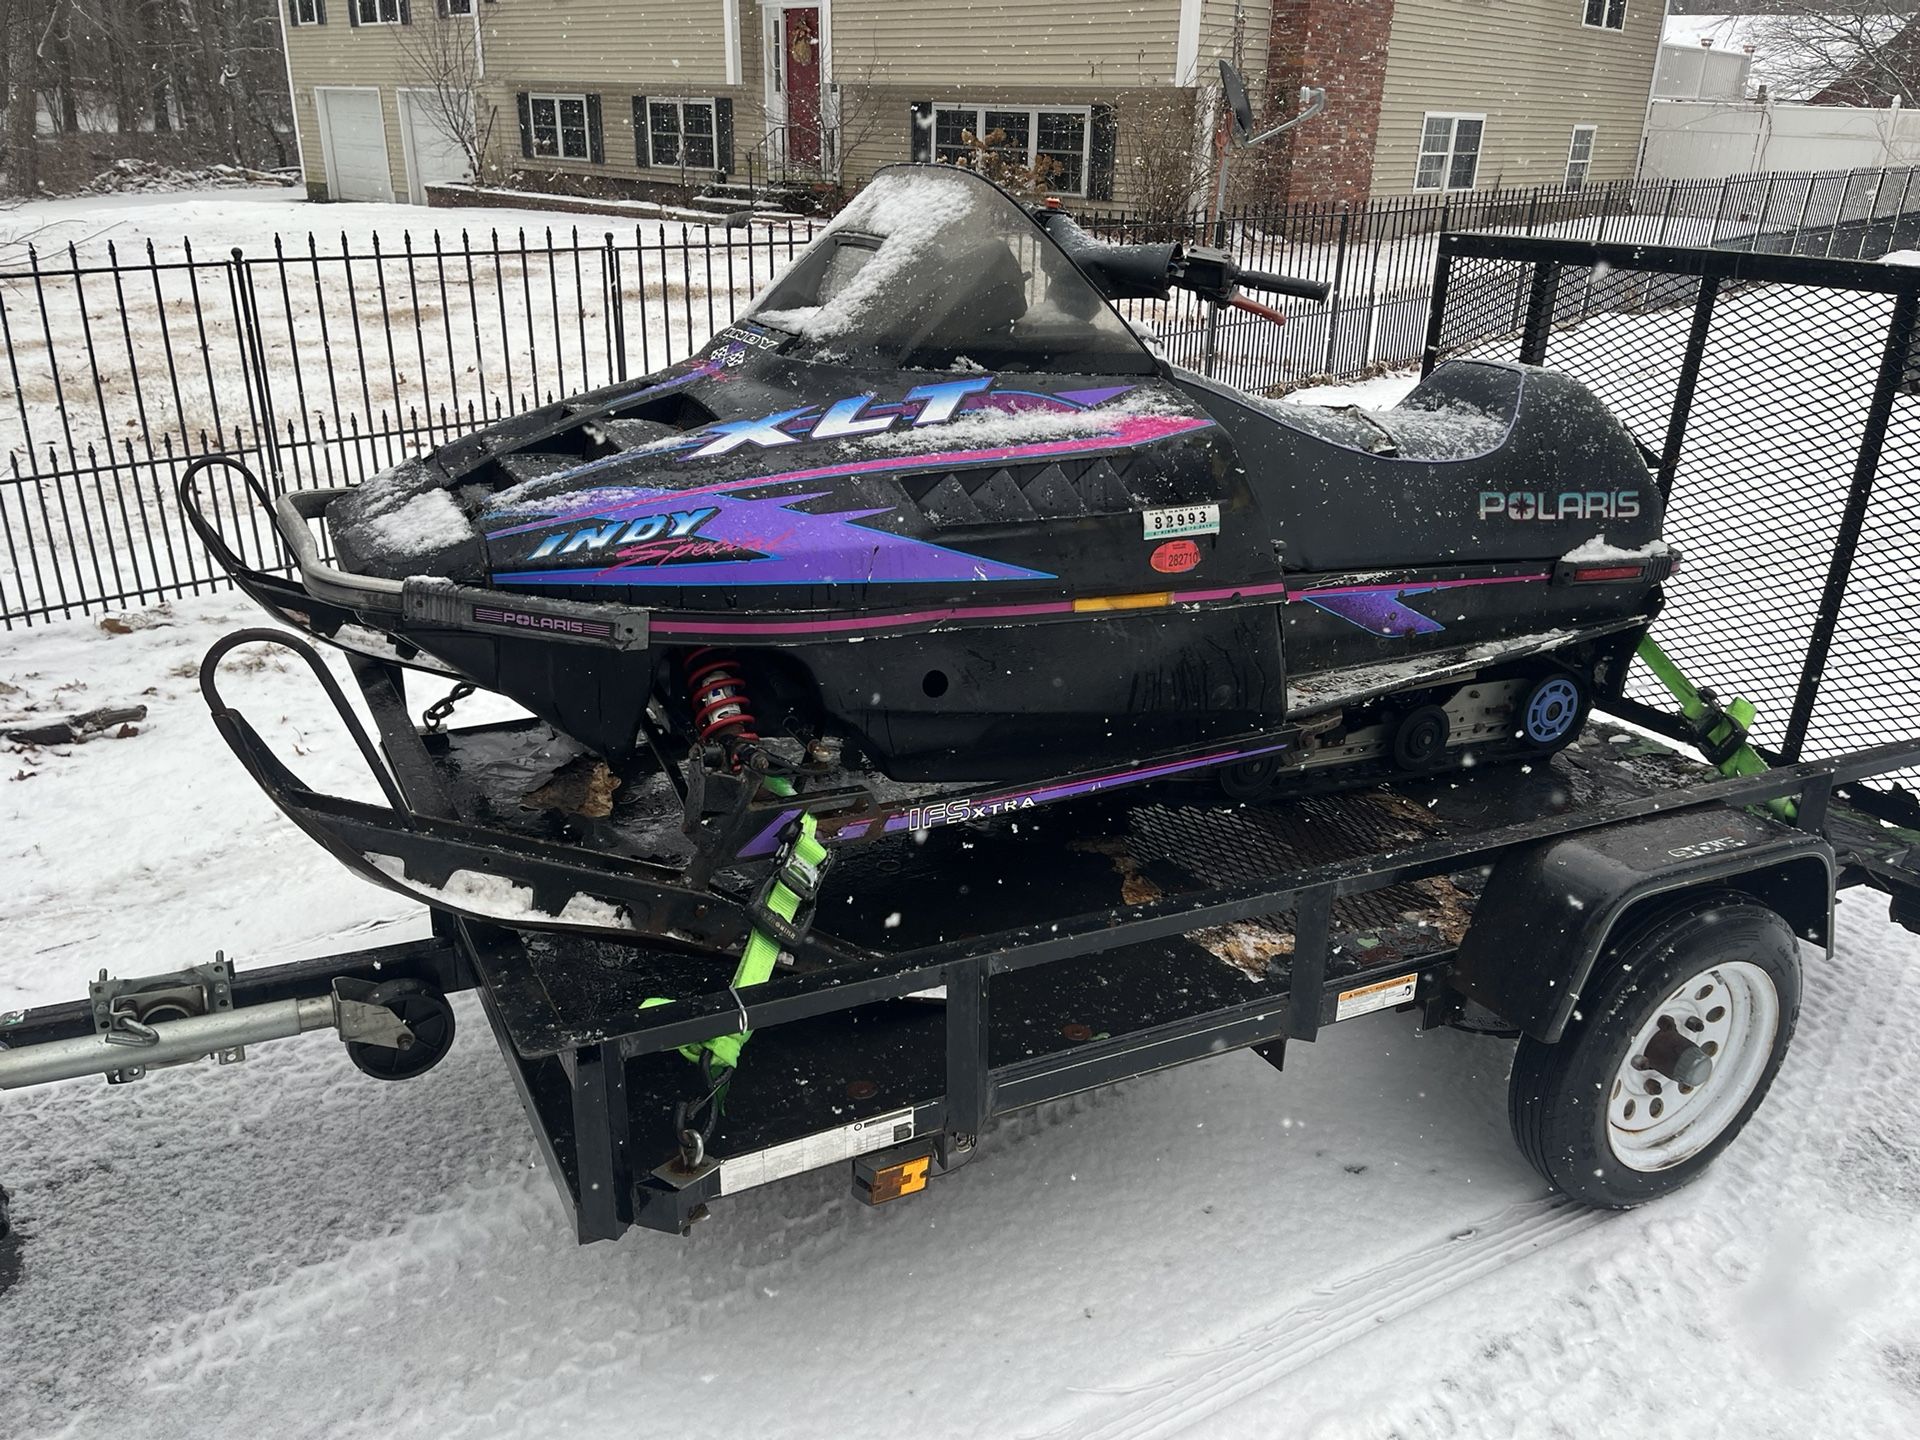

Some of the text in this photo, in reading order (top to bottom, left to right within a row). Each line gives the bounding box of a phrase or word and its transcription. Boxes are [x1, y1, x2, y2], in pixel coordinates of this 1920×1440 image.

[723, 327, 779, 350] INDY
[675, 376, 994, 462] XLT
[1479, 490, 1640, 521] POLARIS
[527, 506, 721, 561] INDY
[594, 529, 797, 577] Special
[1168, 551, 1199, 568] 282710
[503, 612, 584, 633] POLARIS
[909, 799, 971, 832] IFS
